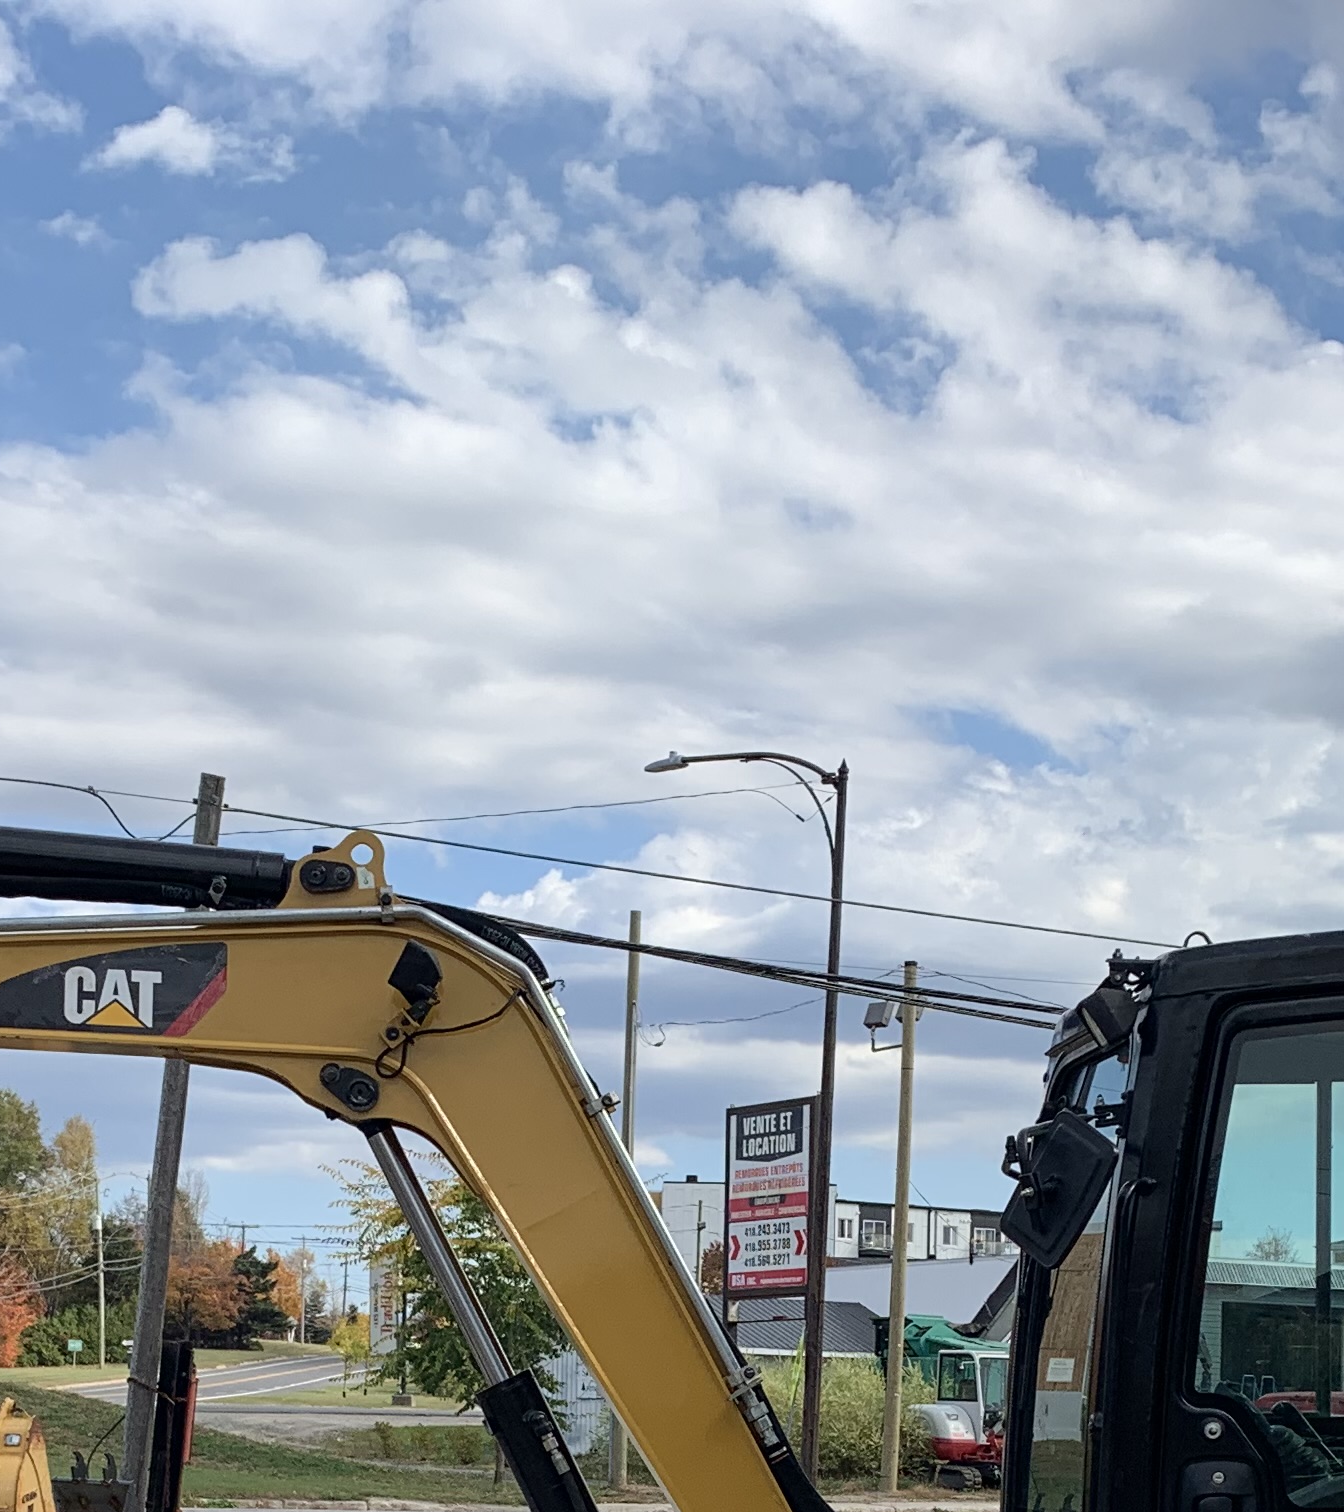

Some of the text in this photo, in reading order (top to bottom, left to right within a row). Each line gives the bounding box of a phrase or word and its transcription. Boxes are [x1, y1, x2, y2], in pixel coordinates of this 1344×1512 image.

[64, 966, 163, 1028] CAT
[742, 1111, 793, 1136] VENTE ET
[742, 1133, 796, 1157] LOCATION
